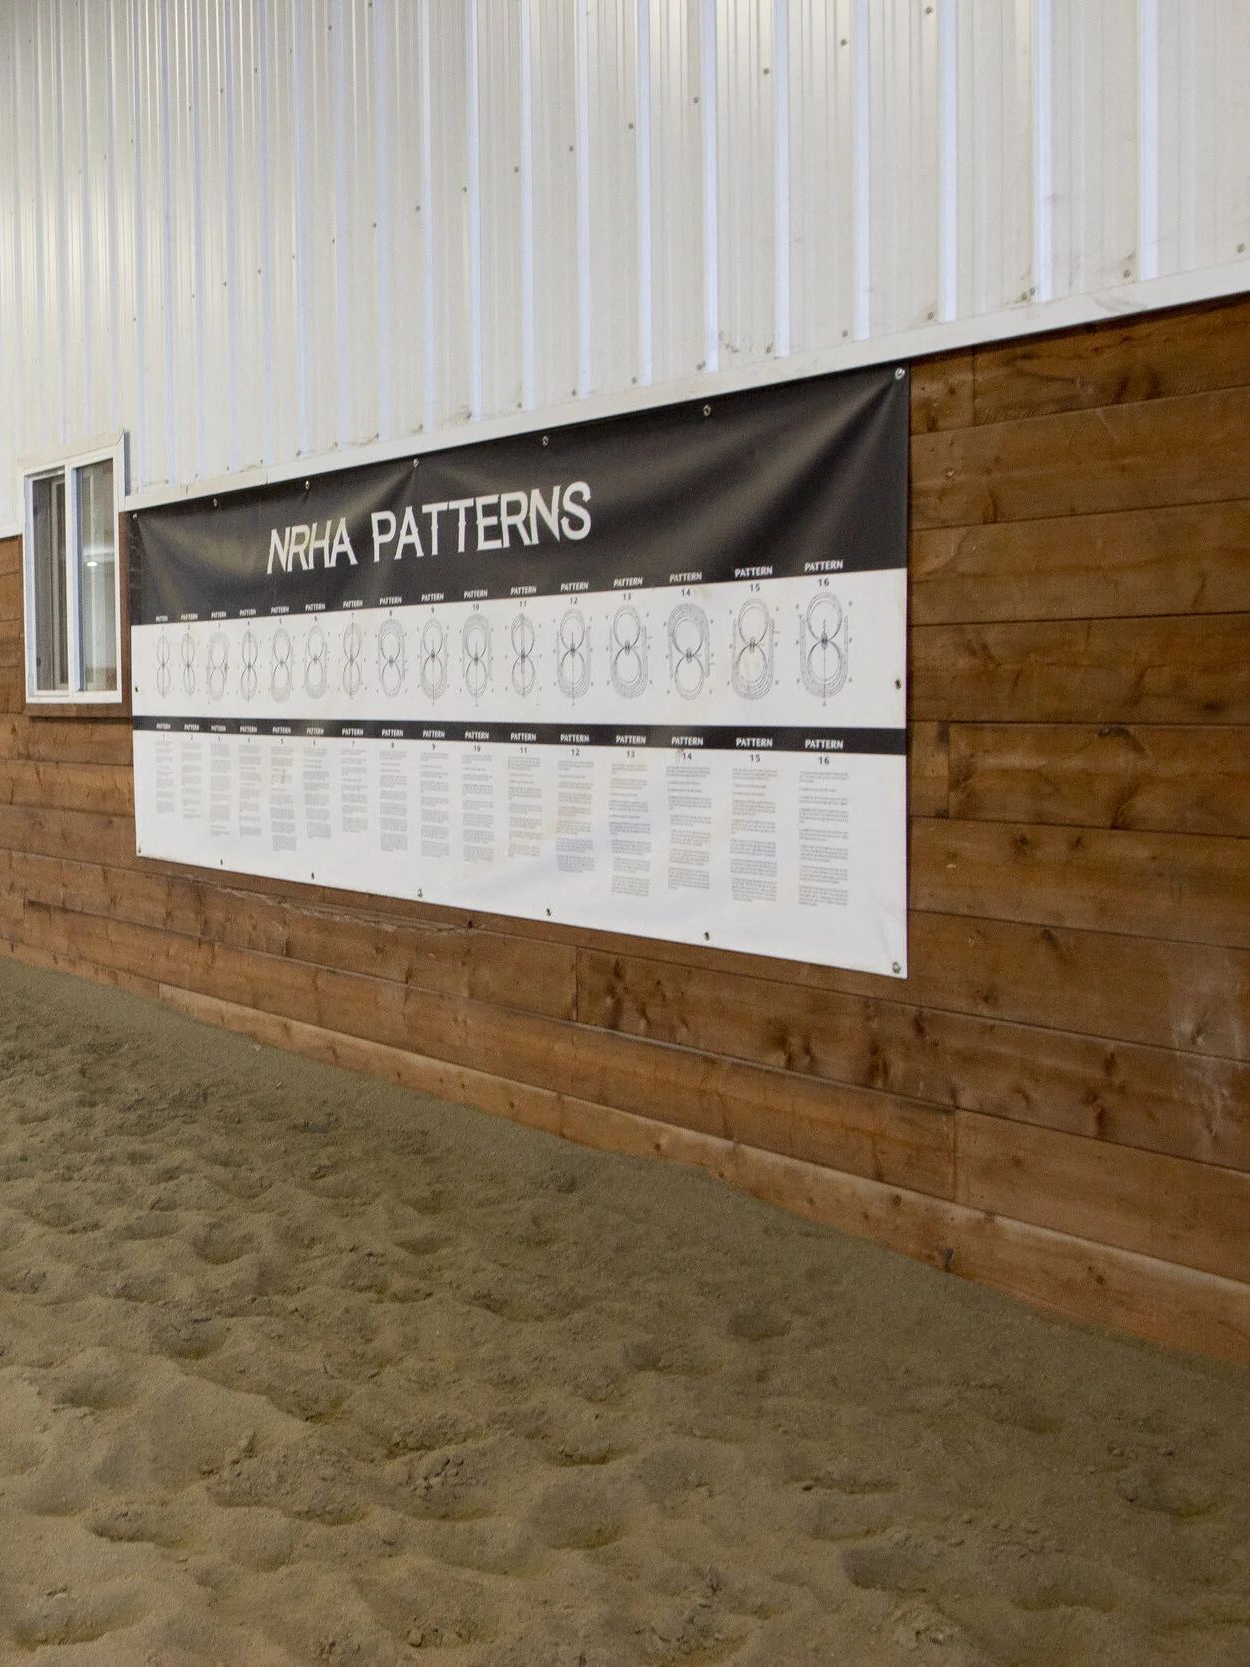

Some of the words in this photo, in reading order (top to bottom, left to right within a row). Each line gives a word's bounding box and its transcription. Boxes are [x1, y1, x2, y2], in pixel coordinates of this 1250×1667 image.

[266, 516, 359, 575] NRHA
[370, 480, 592, 563] PATTERNS
[804, 560, 844, 572] PATTERN
[734, 566, 773, 577] PATTERN
[613, 577, 643, 587] PATTERN
[669, 571, 702, 583] PATTERN
[560, 581, 589, 591] PATTERN
[817, 577, 830, 588] 16
[510, 585, 537, 595] PATTERN
[681, 588, 691, 597] 14
[749, 583, 761, 593] 15
[421, 593, 444, 602] PATTERN
[463, 589, 488, 600] PATTERN
[622, 592, 632, 601] 13
[342, 600, 363, 609] PATTERN
[379, 596, 402, 605] PATTERN
[270, 606, 290, 614] PATTERN
[305, 603, 326, 611] PATTERN
[472, 603, 480, 611] 10
[272, 726, 292, 734] PATTERN
[306, 727, 325, 735] PATTERN
[341, 727, 364, 737] PATTERN
[381, 728, 404, 738] PATTERN
[422, 729, 445, 739] PATTERN
[464, 730, 490, 741] PATTERN
[510, 732, 537, 742] PATTERN
[560, 733, 590, 743] PATTERN
[616, 734, 647, 745] PATTERN
[671, 735, 704, 747] PATTERN
[735, 736, 773, 749] PATTERN
[804, 738, 844, 750] PATTERN
[570, 748, 580, 757] 12
[626, 750, 636, 759] 13
[681, 751, 693, 761] 14
[749, 753, 761, 763] 15
[818, 755, 831, 766] 16
